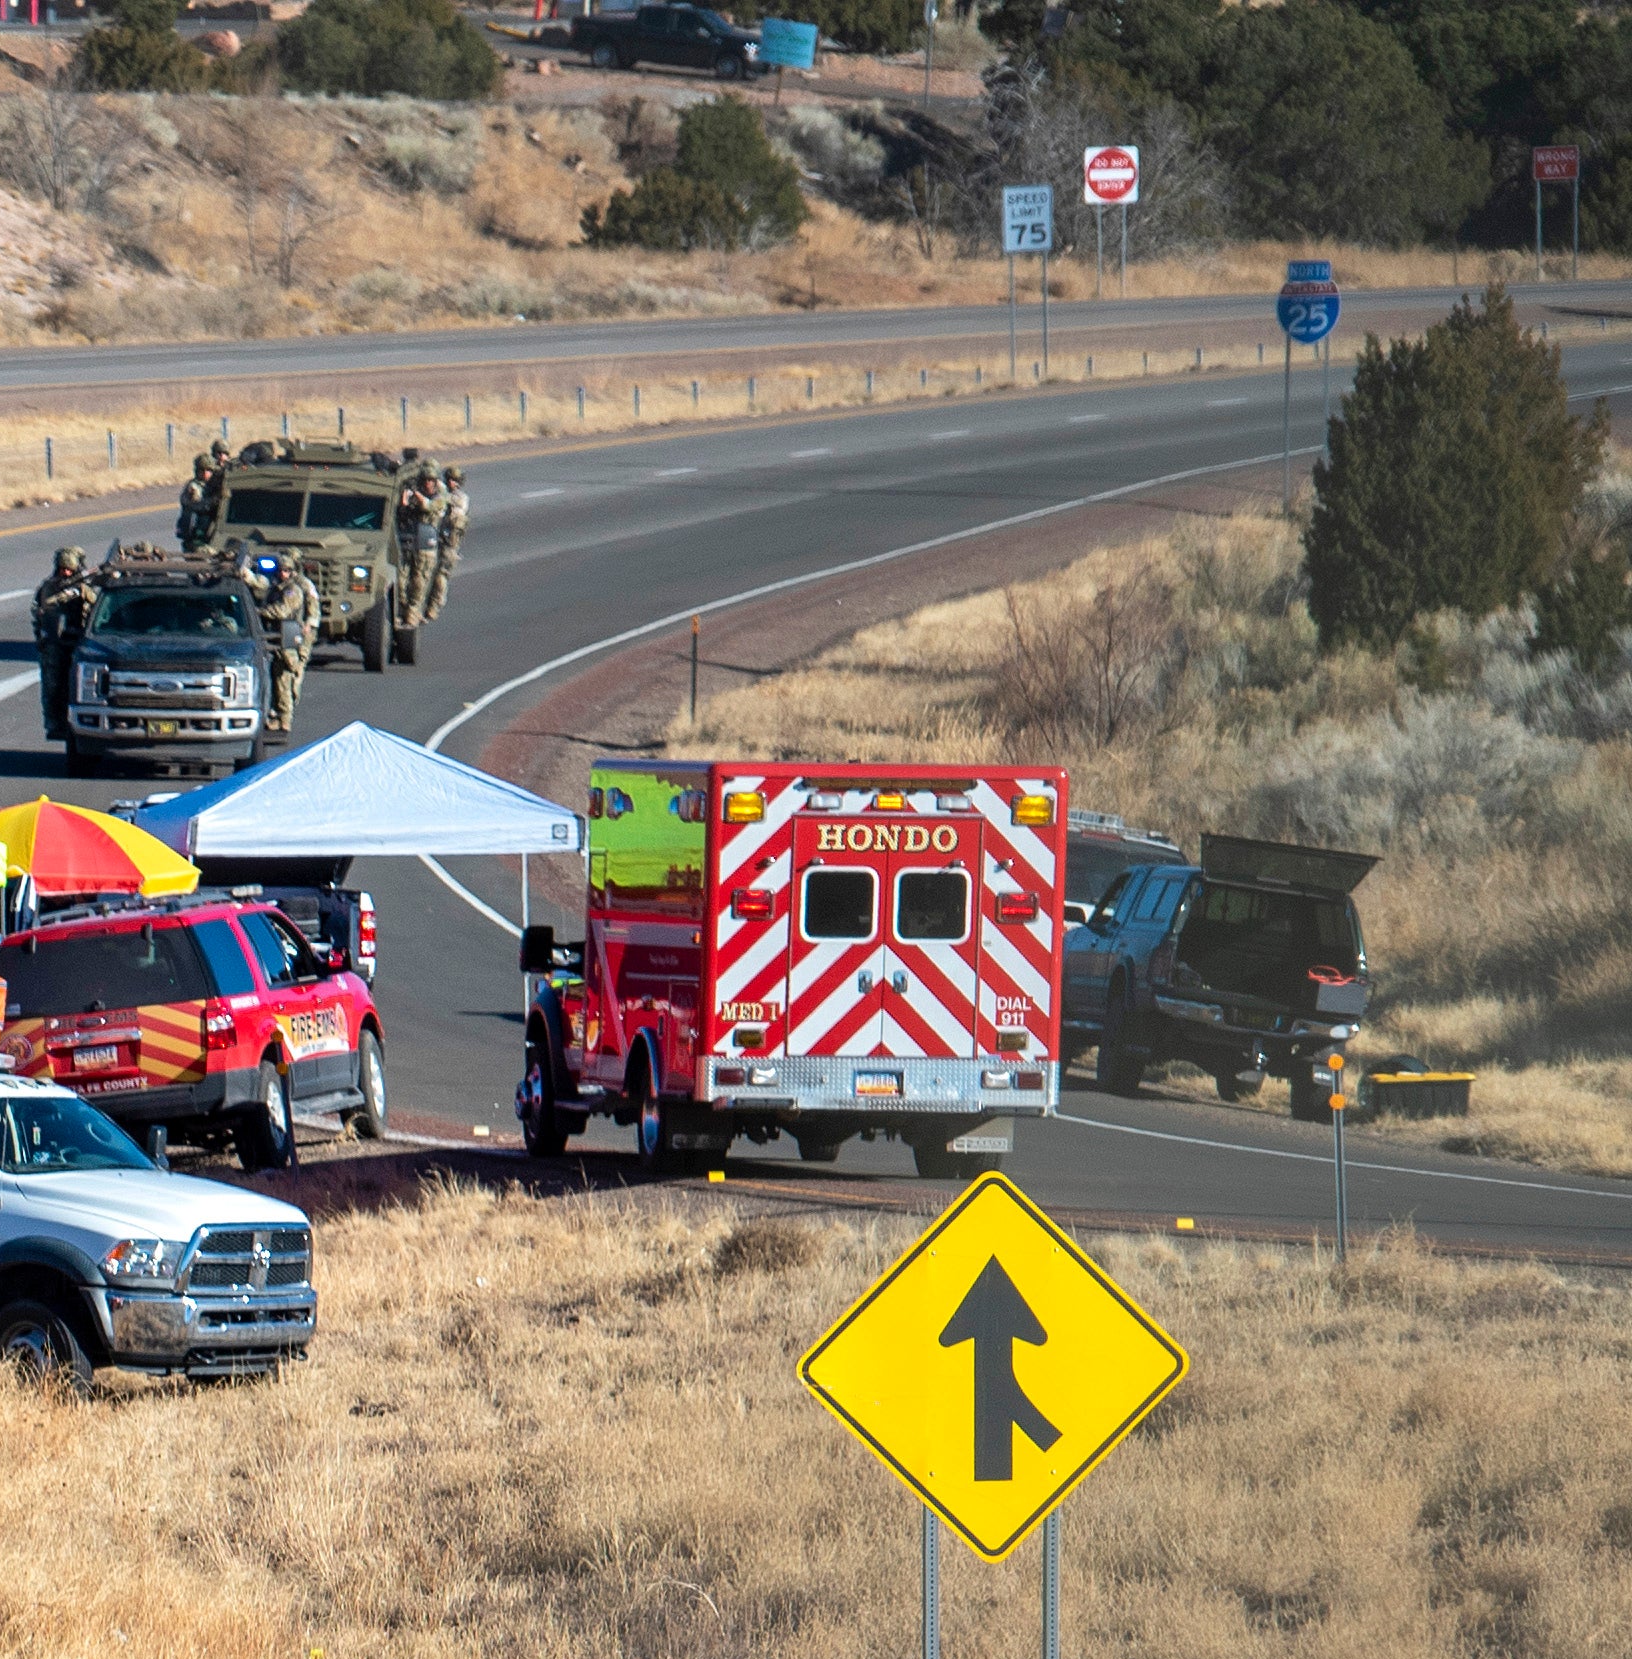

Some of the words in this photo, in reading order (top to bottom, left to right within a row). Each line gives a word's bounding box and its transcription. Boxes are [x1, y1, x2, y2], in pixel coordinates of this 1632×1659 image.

[1537, 151, 1577, 162] WRONG
[1544, 164, 1567, 174] WAY
[1007, 191, 1048, 204] SPEED
[1011, 206, 1043, 218] LIMIT
[1010, 223, 1046, 245] 75
[1290, 264, 1329, 276] NORTH
[1289, 303, 1329, 334] 25
[817, 824, 959, 853] HONDO
[997, 996, 1032, 1011] DIAL
[721, 1001, 764, 1021] MED
[769, 1003, 778, 1021] 1
[1001, 1011, 1025, 1025] 911
[103, 1076, 148, 1092] COUNTY
